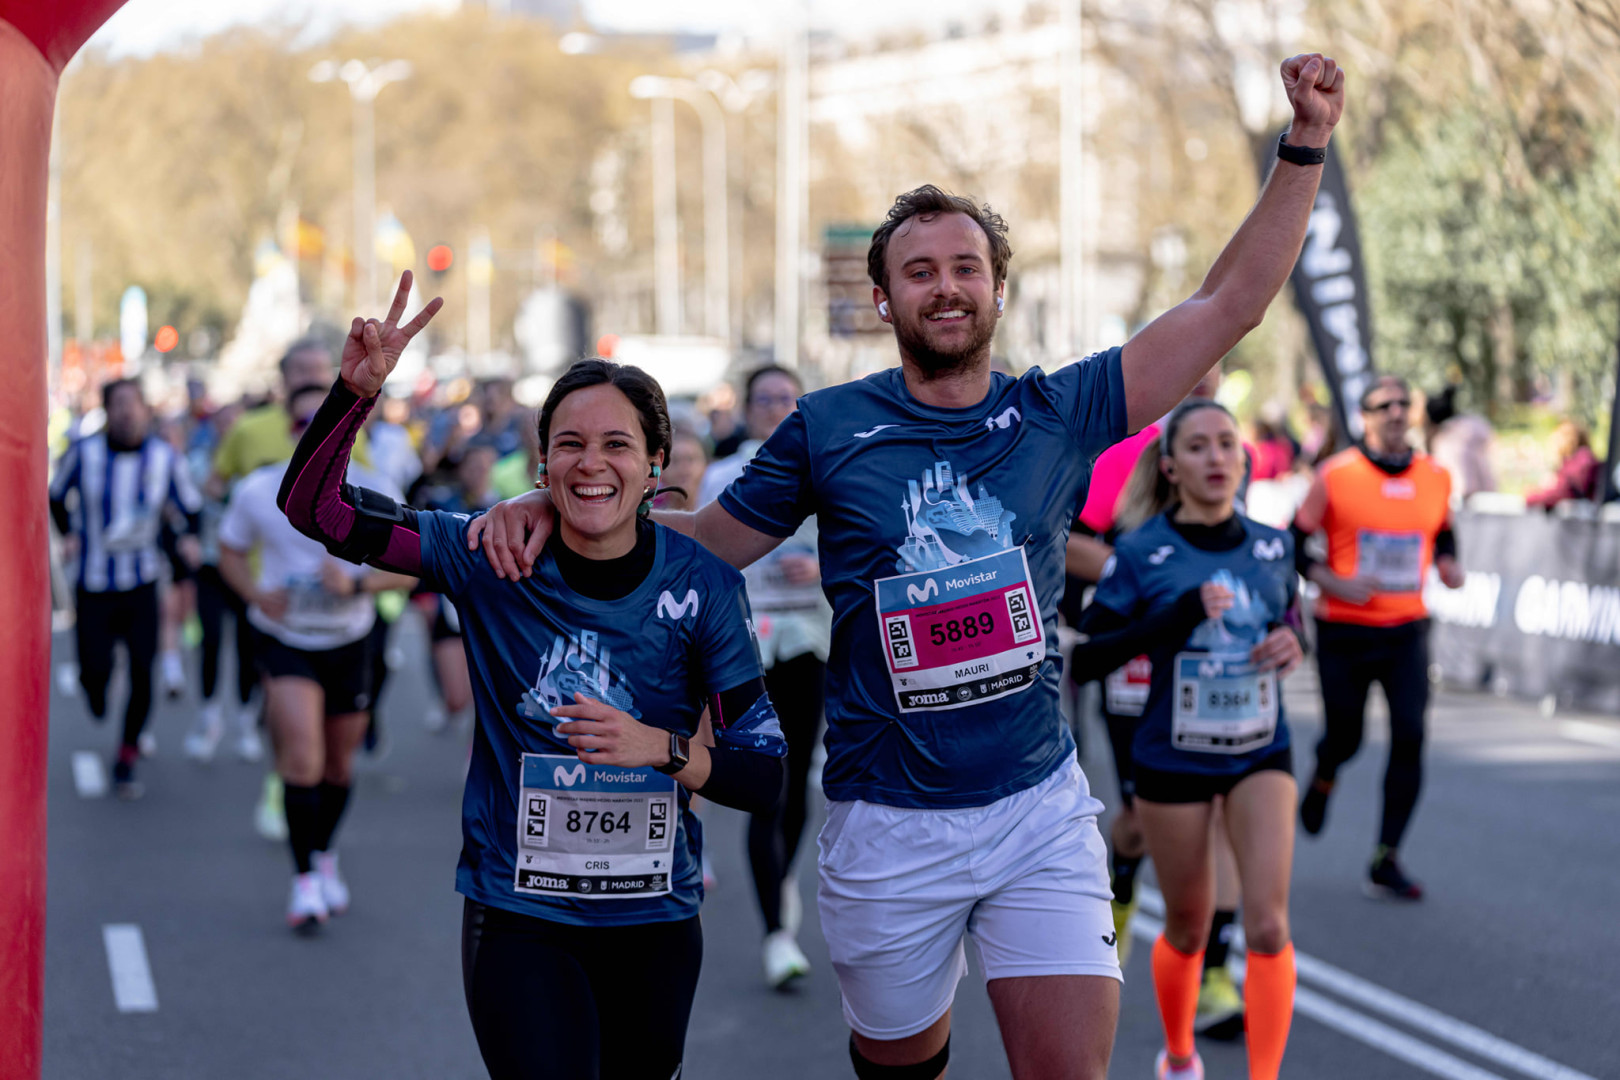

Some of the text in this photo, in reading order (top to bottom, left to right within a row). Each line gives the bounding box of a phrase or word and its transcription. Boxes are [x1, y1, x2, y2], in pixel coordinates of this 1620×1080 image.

[945, 570, 998, 591] Movistar
[930, 611, 994, 646] 5889
[954, 663, 990, 679] MAURI
[990, 674, 1023, 691] MADRID
[594, 770, 647, 783] Movistar
[566, 810, 631, 834] 8764
[585, 861, 610, 870] CRIS
[611, 880, 645, 890] MADRID
